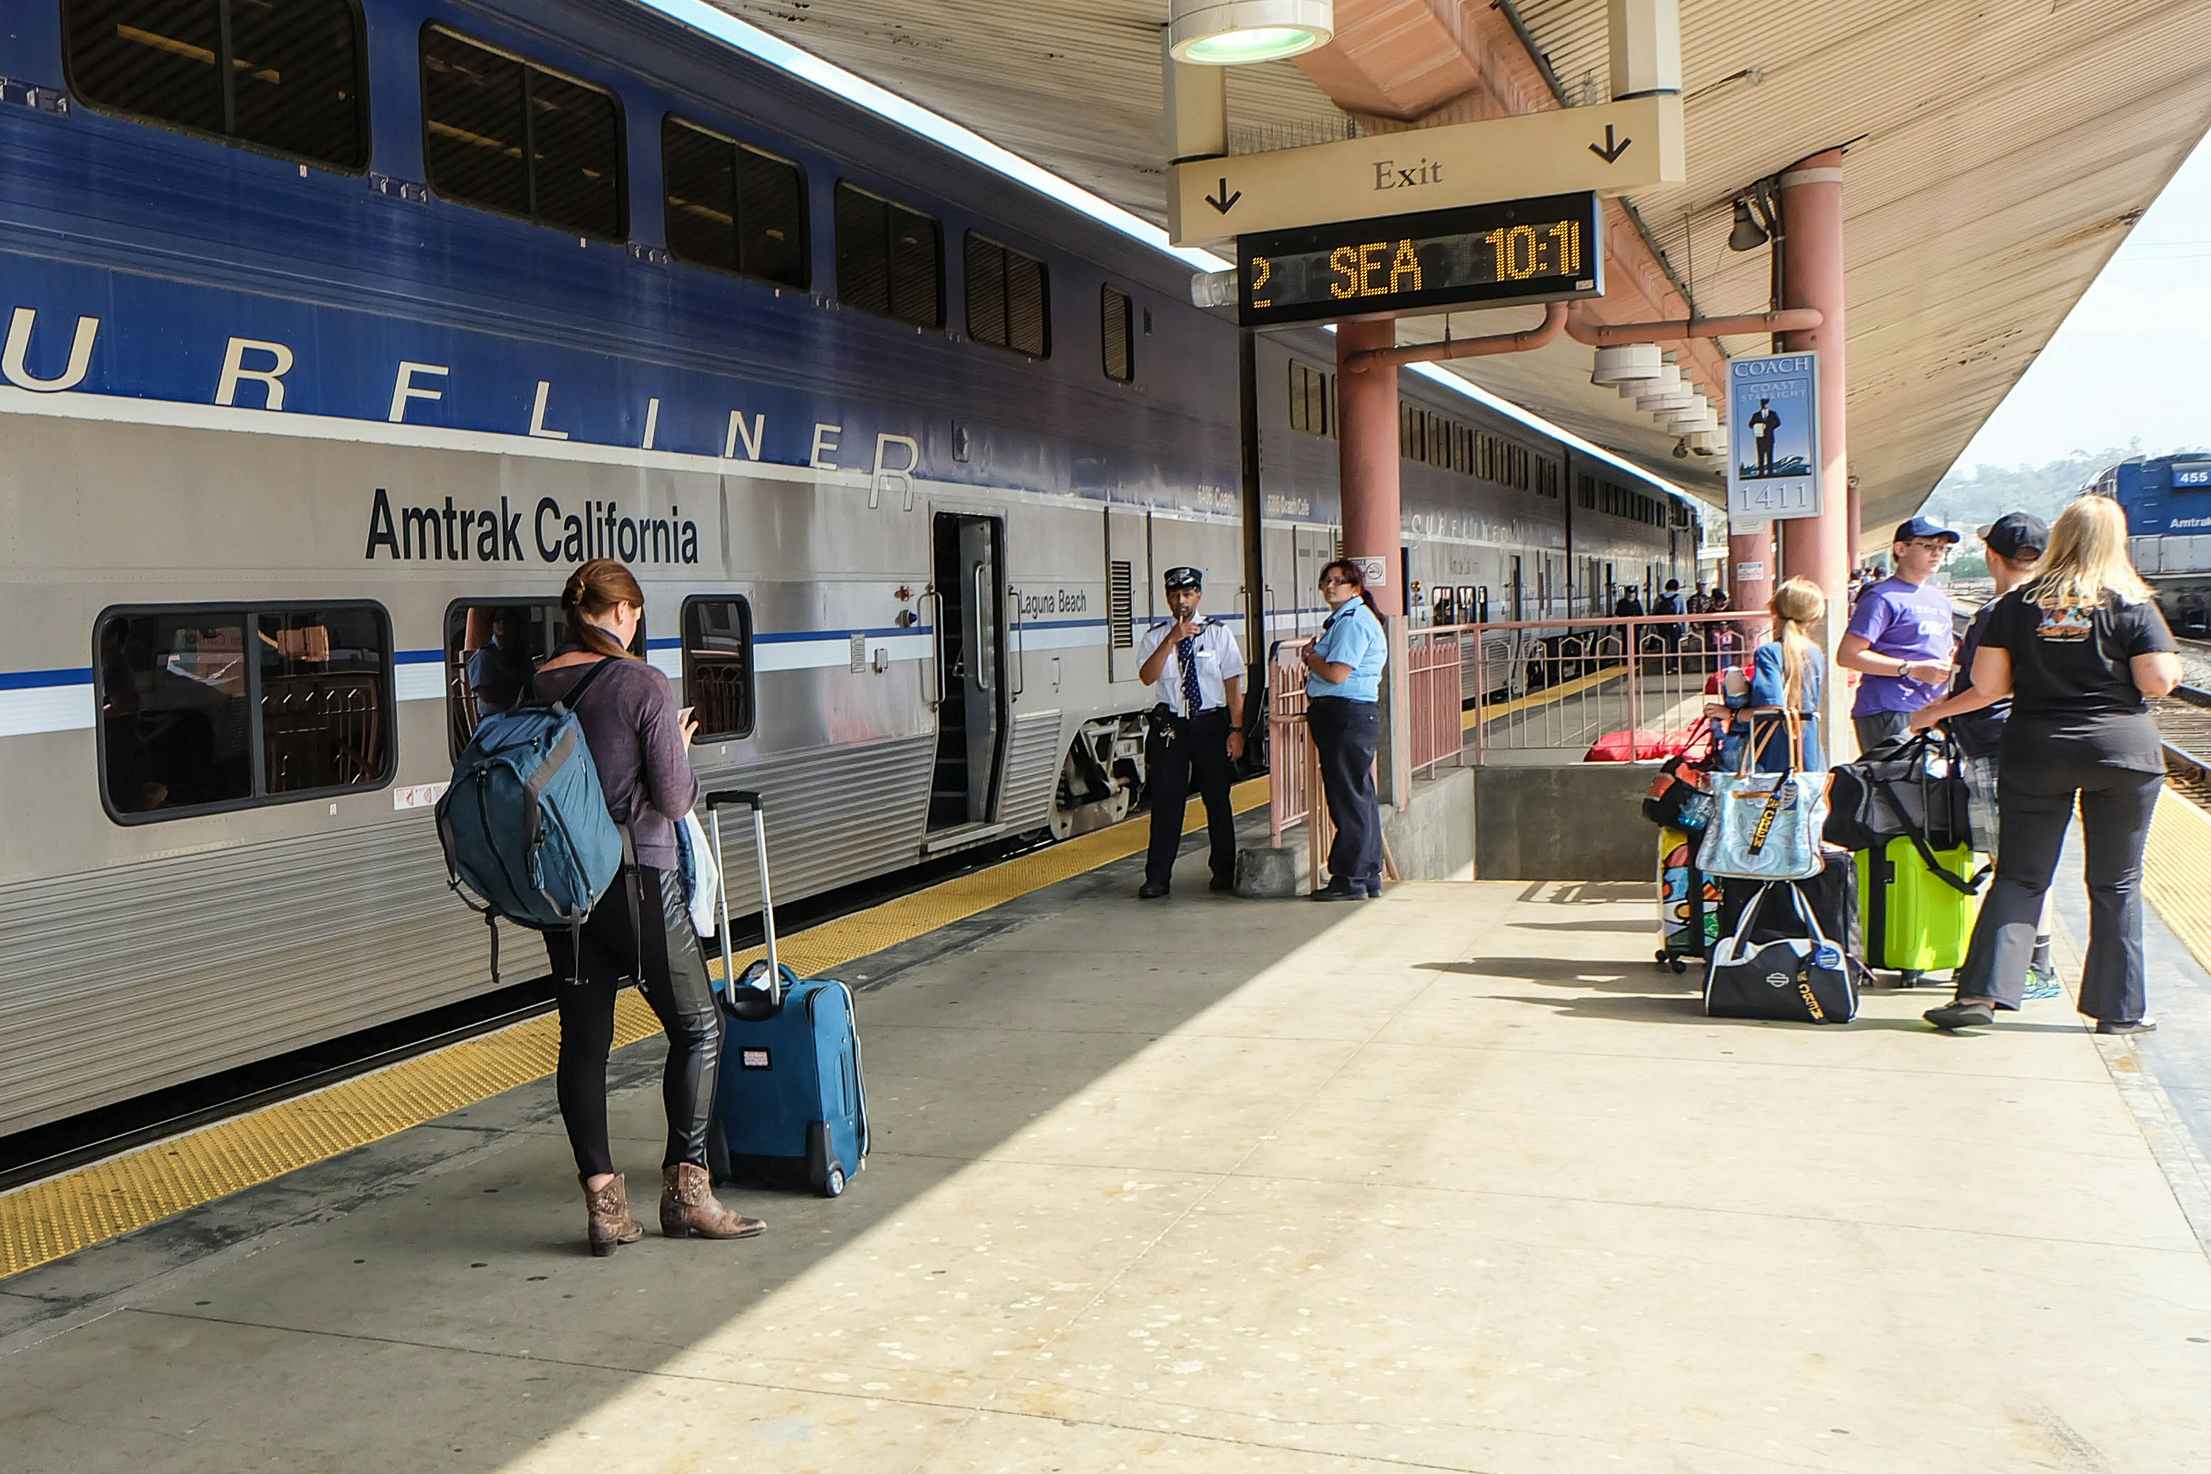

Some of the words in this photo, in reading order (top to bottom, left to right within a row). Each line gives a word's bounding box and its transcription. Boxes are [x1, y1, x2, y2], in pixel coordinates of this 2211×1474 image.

[1372, 157, 1443, 191] Exit
[1329, 238, 1422, 299] SEA
[1734, 357, 1809, 378] COACH
[1750, 381, 1796, 394] COAST
[2180, 471, 2209, 484] 455
[1740, 482, 1808, 512] 1411
[365, 488, 525, 561] Amtrak
[534, 496, 699, 564] California
[1020, 589, 1055, 619] Laguna
[1058, 589, 1087, 613] Beach
